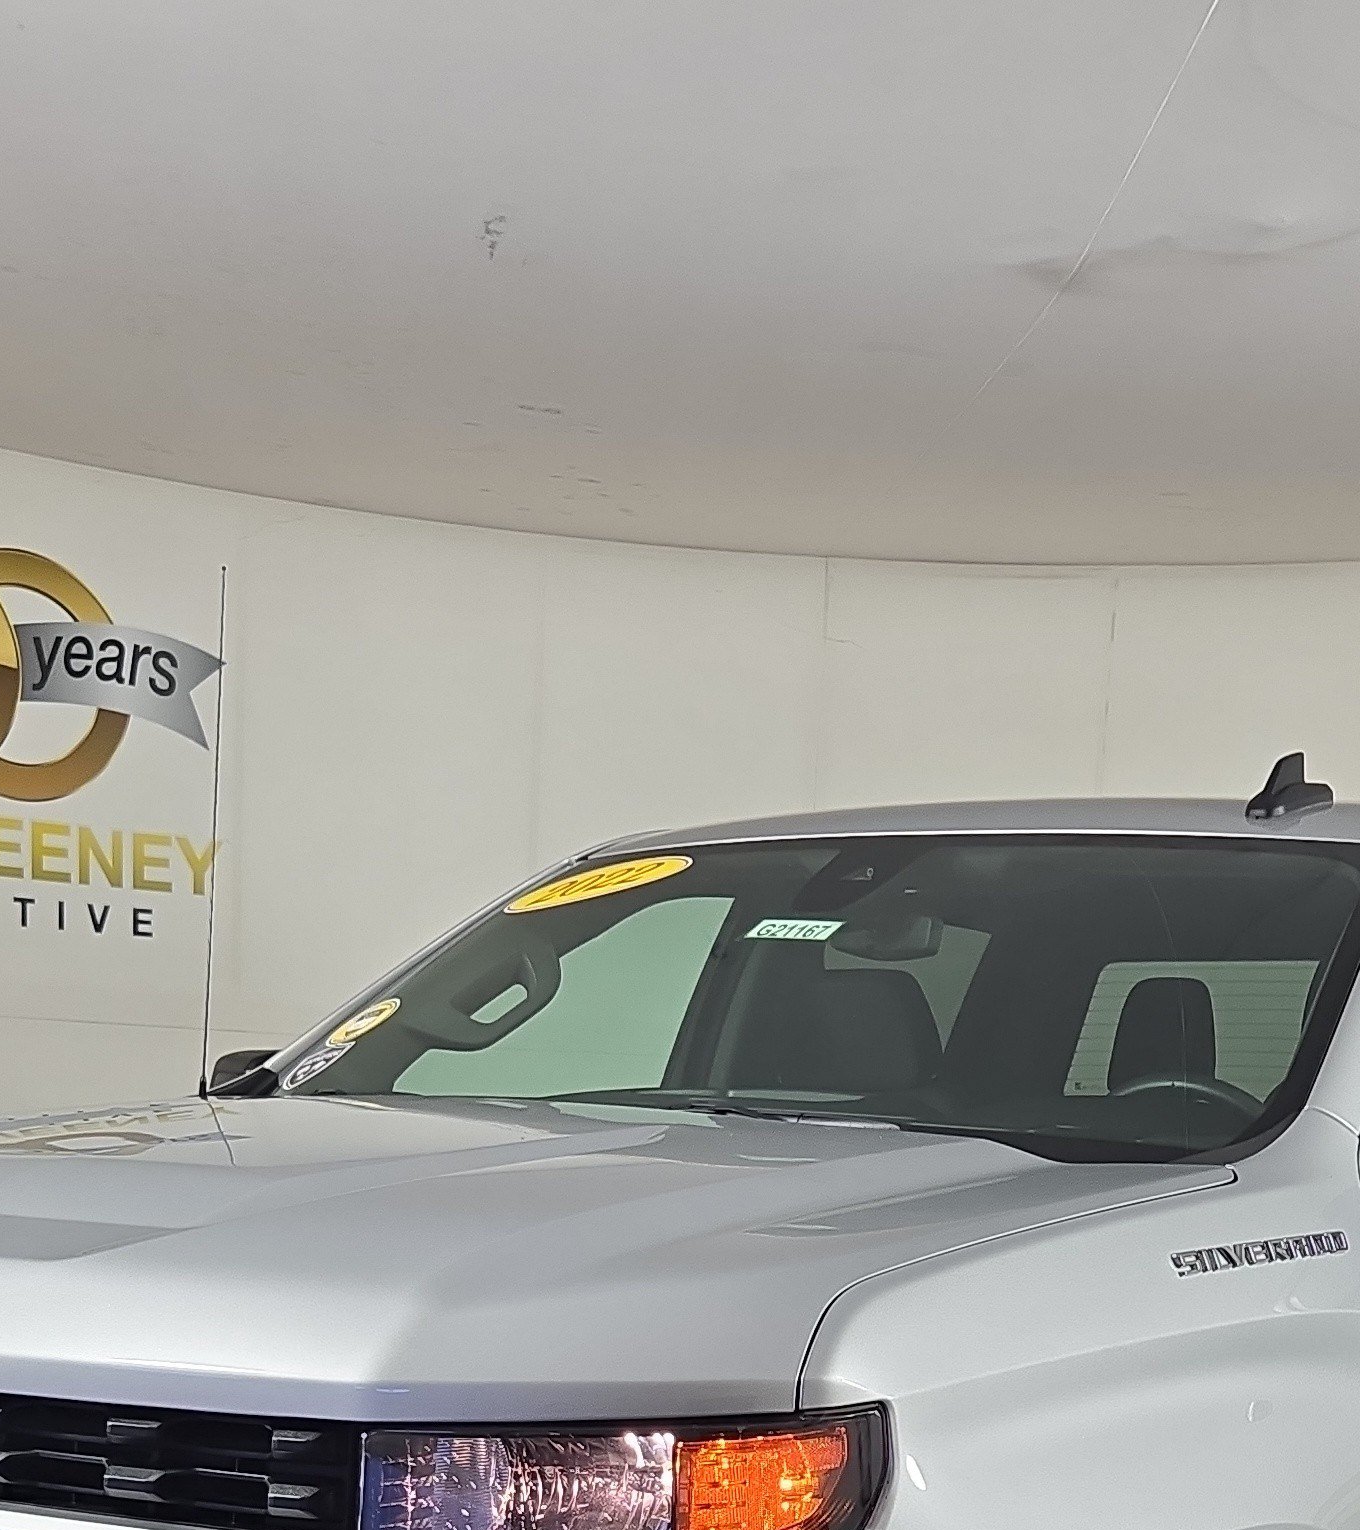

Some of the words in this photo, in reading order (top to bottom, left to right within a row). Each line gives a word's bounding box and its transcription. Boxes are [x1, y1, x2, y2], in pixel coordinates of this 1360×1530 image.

[32, 628, 179, 697] years
[526, 861, 666, 907] 2022
[756, 923, 833, 939] G21167
